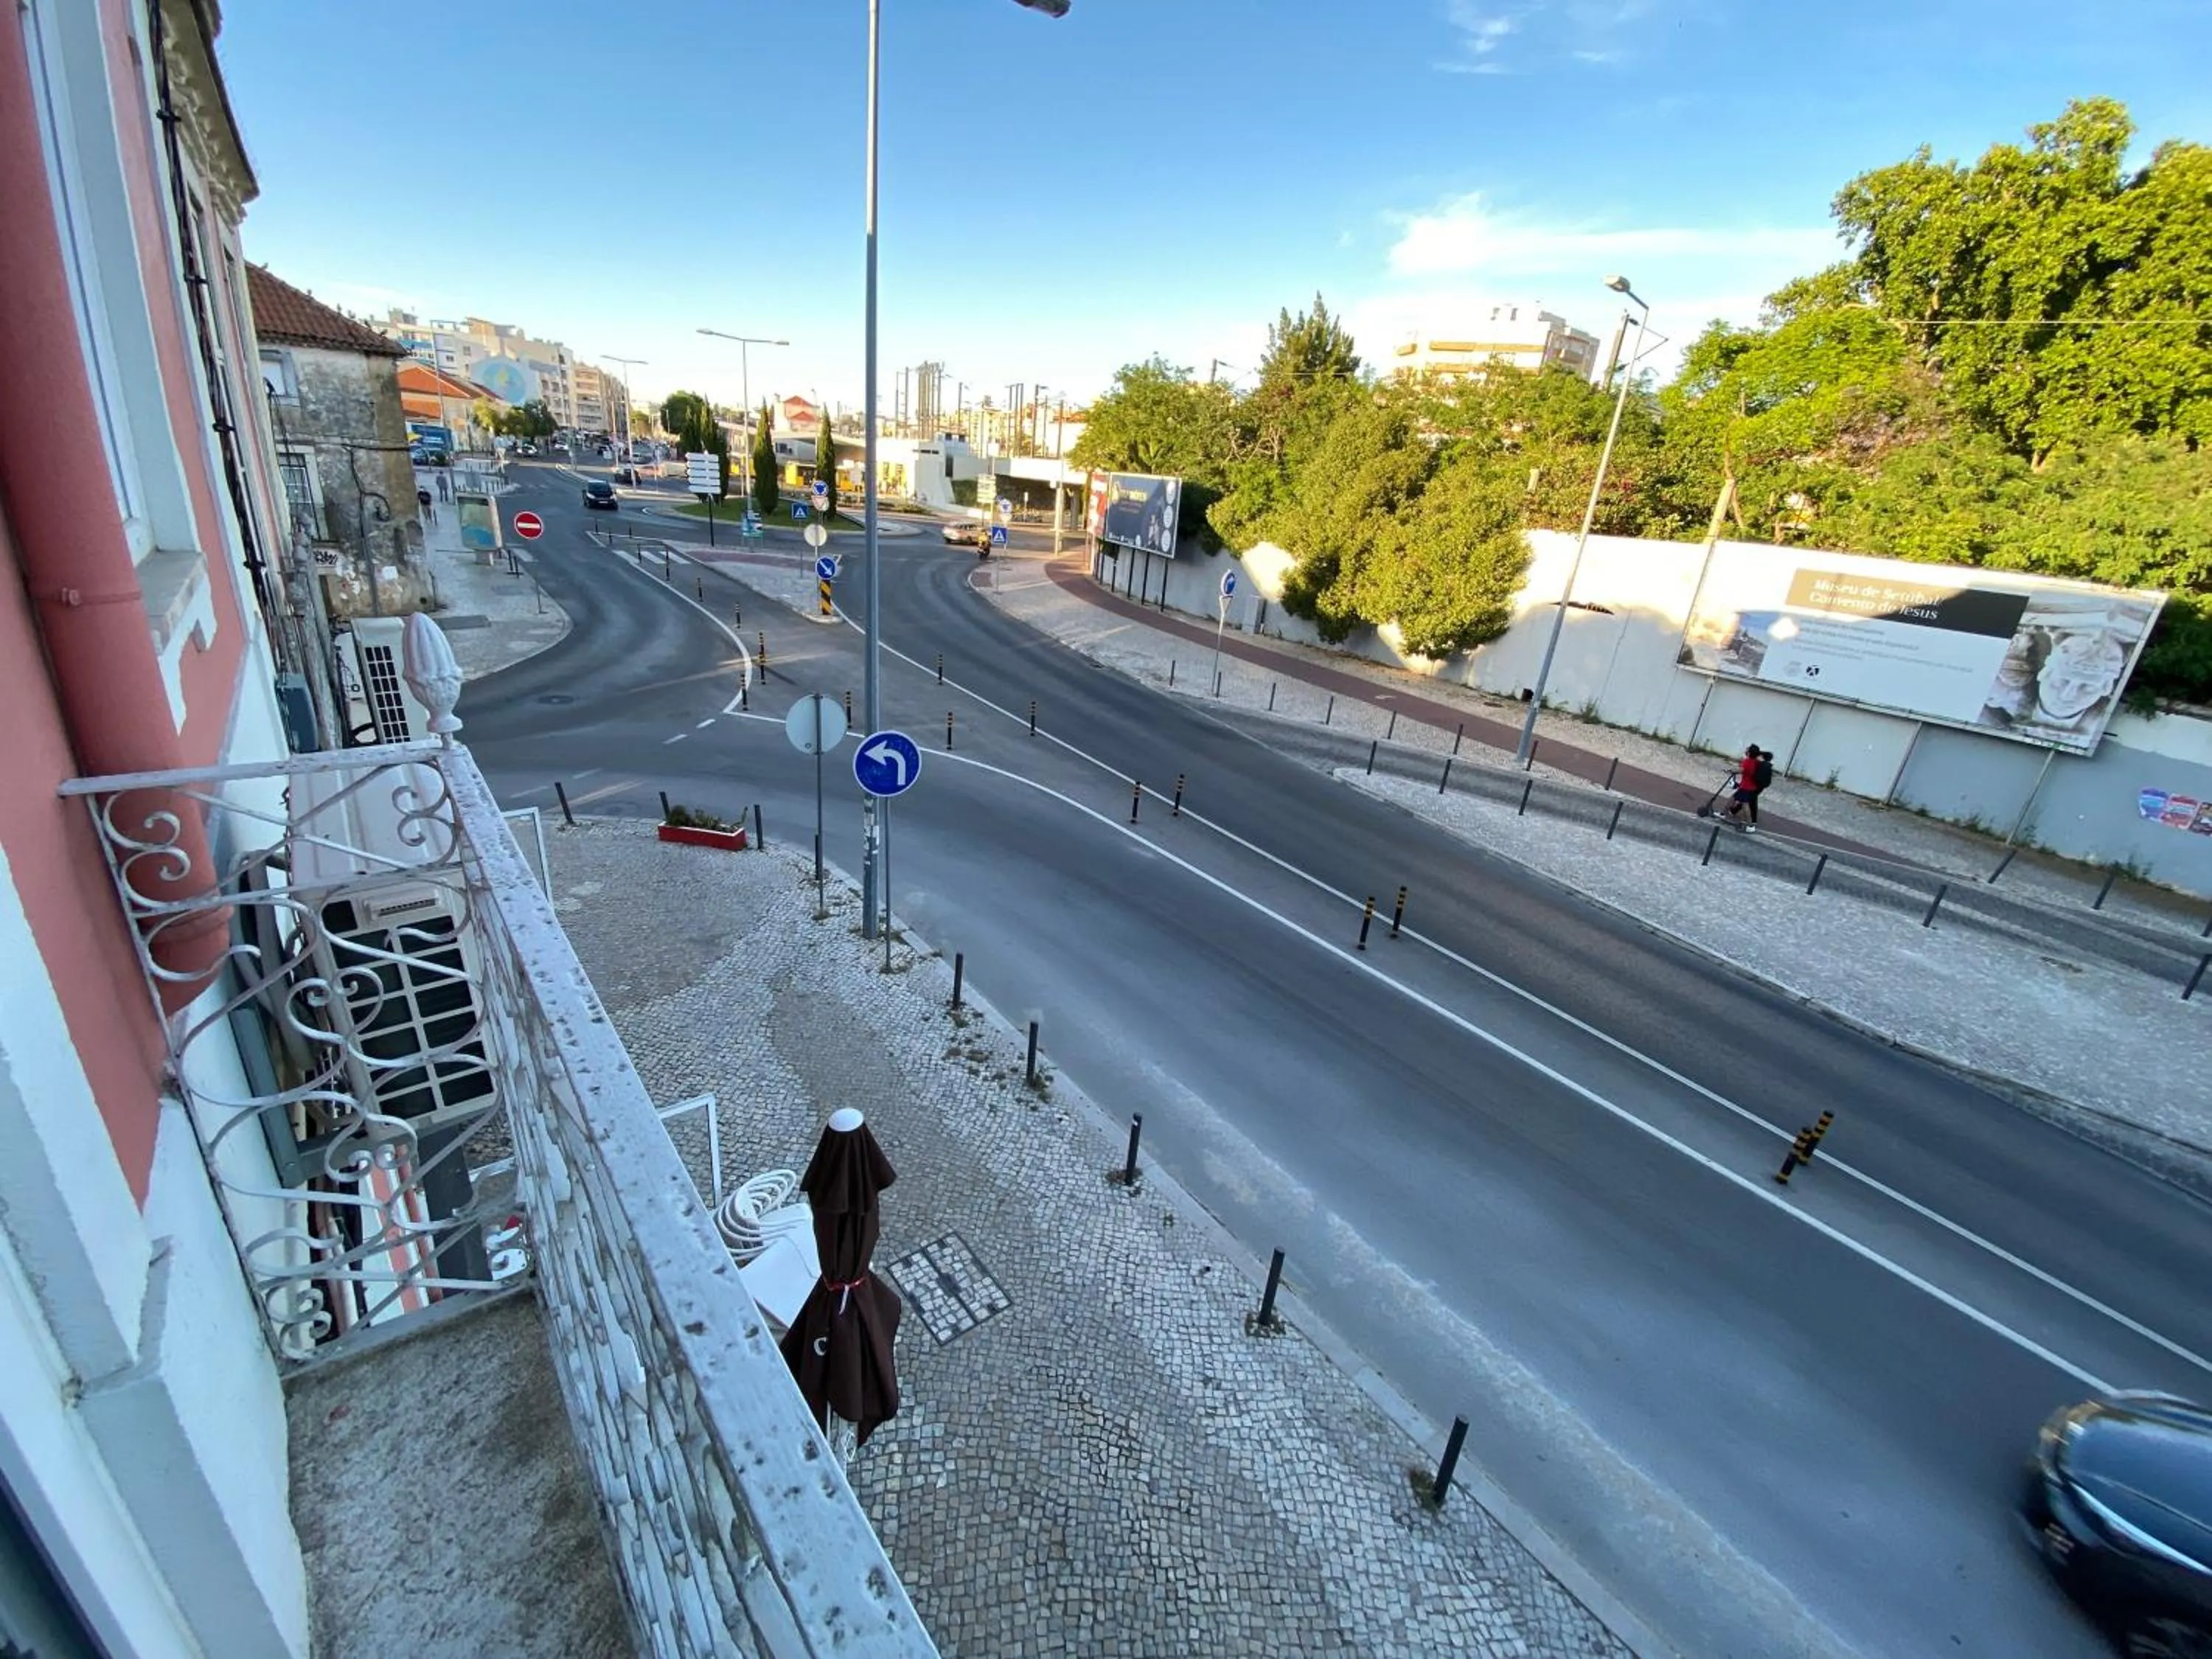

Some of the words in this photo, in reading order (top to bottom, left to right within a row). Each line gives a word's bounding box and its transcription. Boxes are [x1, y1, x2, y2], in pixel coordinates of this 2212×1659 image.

[1860, 585, 1881, 599] de
[1877, 600, 1897, 614] de
[1899, 605, 1938, 620] Jesus
